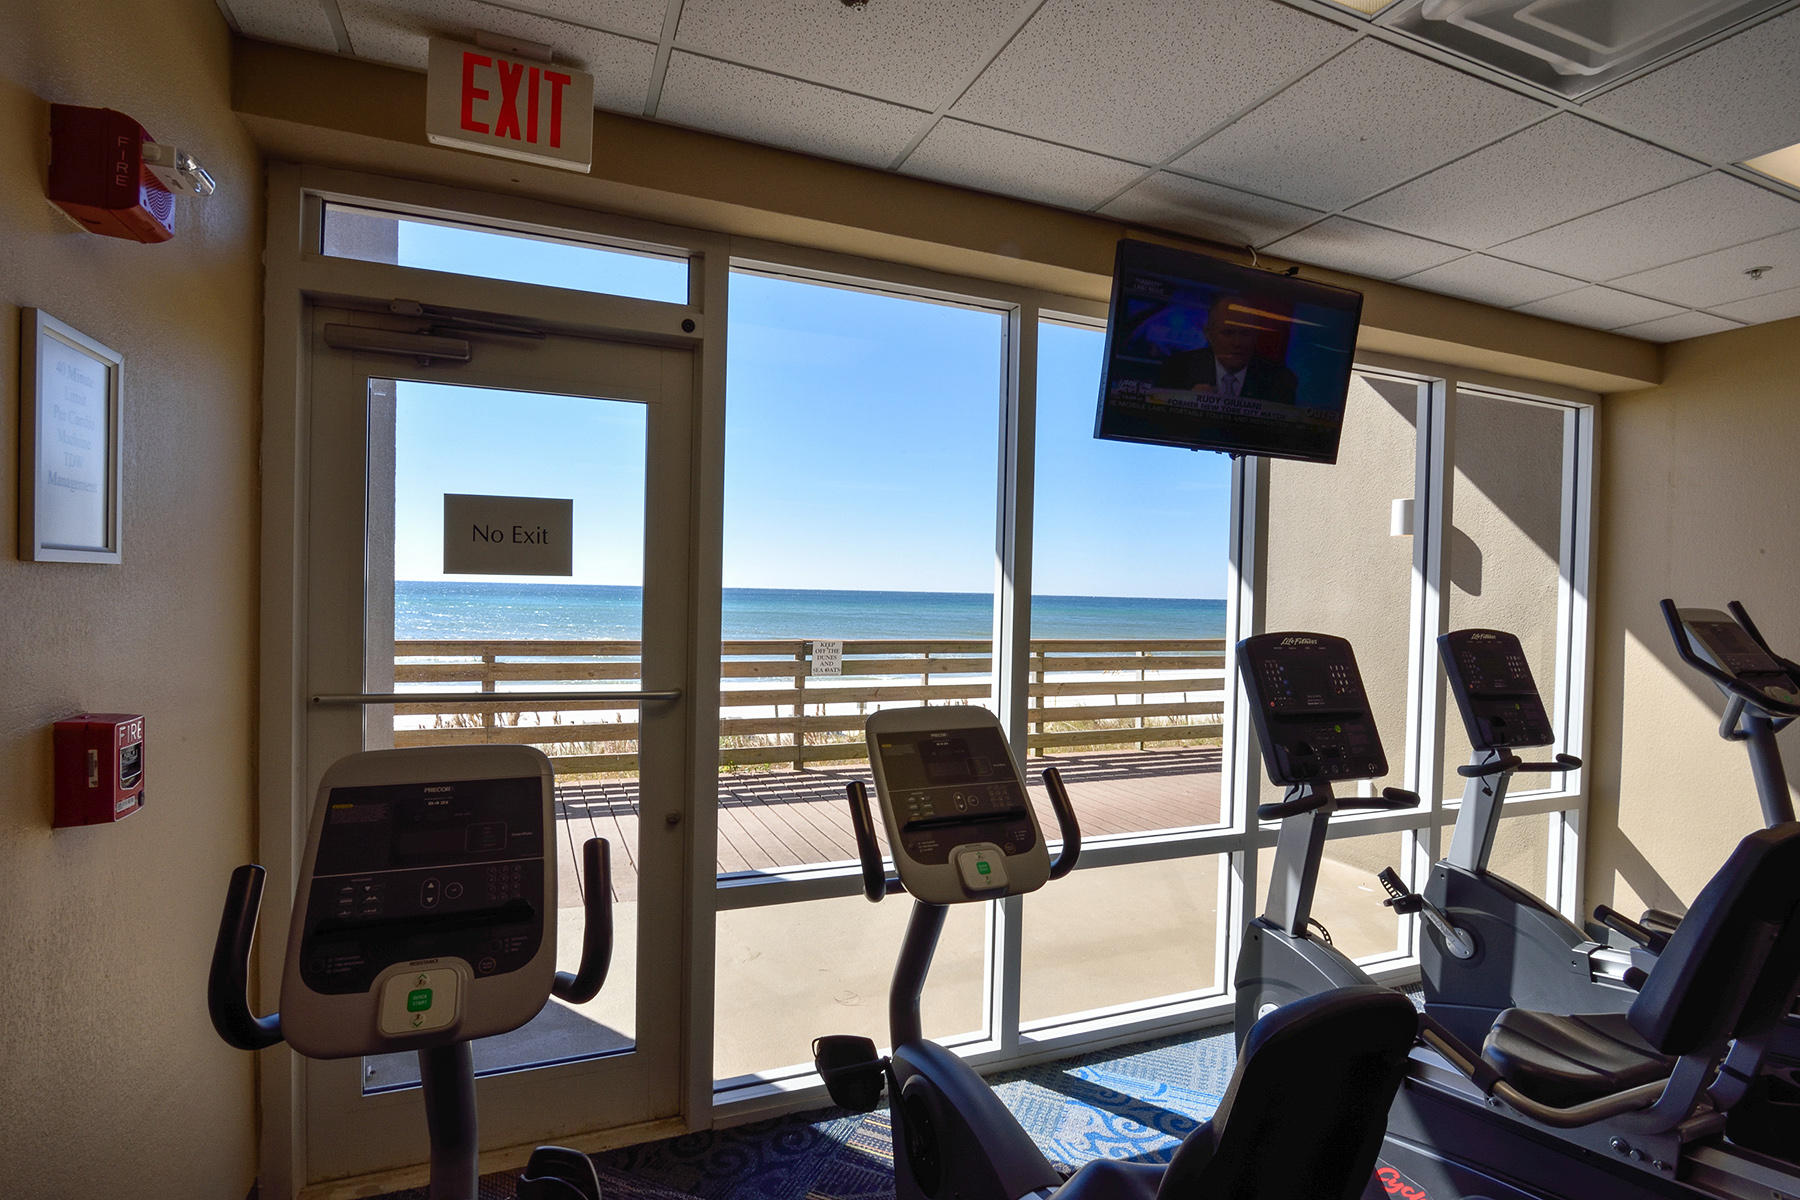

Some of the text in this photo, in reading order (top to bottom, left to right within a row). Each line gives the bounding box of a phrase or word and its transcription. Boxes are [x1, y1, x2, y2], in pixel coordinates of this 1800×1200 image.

[461, 52, 571, 148] EXIT
[115, 136, 129, 187] FIRE
[1197, 394, 1220, 406] RUDY
[472, 524, 549, 545] No Exit
[119, 720, 143, 746] FIRE
